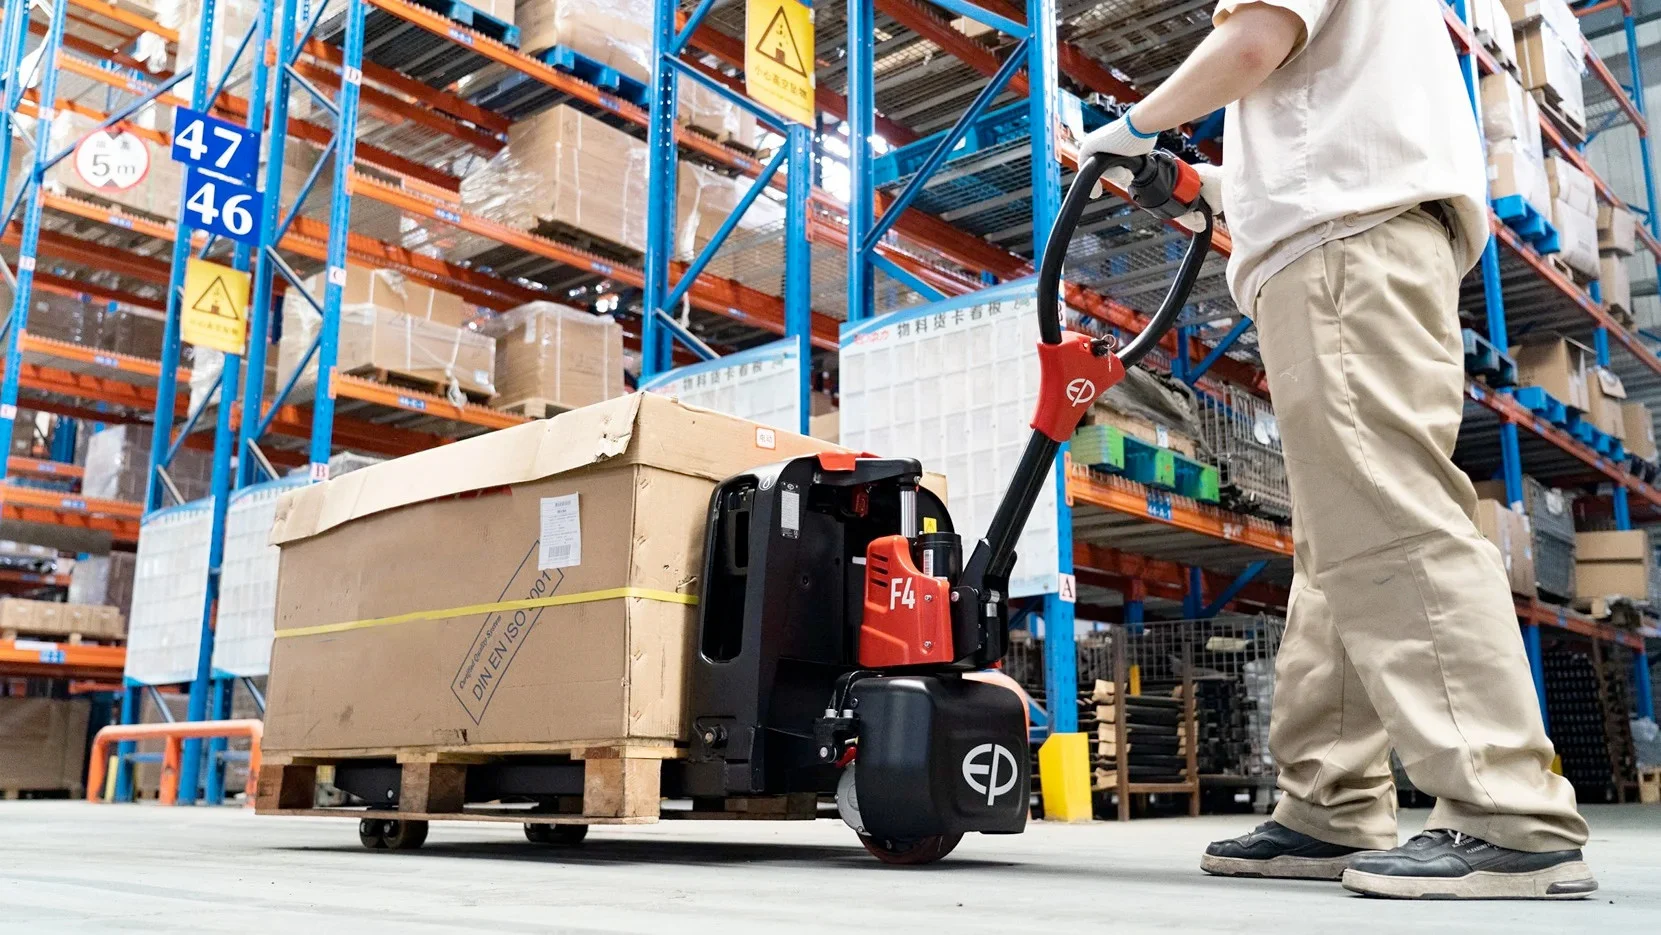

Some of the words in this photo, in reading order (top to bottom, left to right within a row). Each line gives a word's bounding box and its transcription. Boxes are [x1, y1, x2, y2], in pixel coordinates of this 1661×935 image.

[348, 67, 360, 81] D
[174, 119, 243, 169] 47
[186, 182, 253, 236] 46
[333, 269, 344, 282] C
[897, 300, 1001, 338] 物料货卡看板
[316, 464, 326, 477] B
[889, 577, 916, 610] F4
[1062, 577, 1074, 598] A
[460, 662, 474, 689] Certified
[473, 637, 489, 663] Quality
[487, 615, 502, 638] System
[472, 666, 494, 701] DIN
[488, 640, 508, 670] EN
[504, 610, 526, 644] ISO
